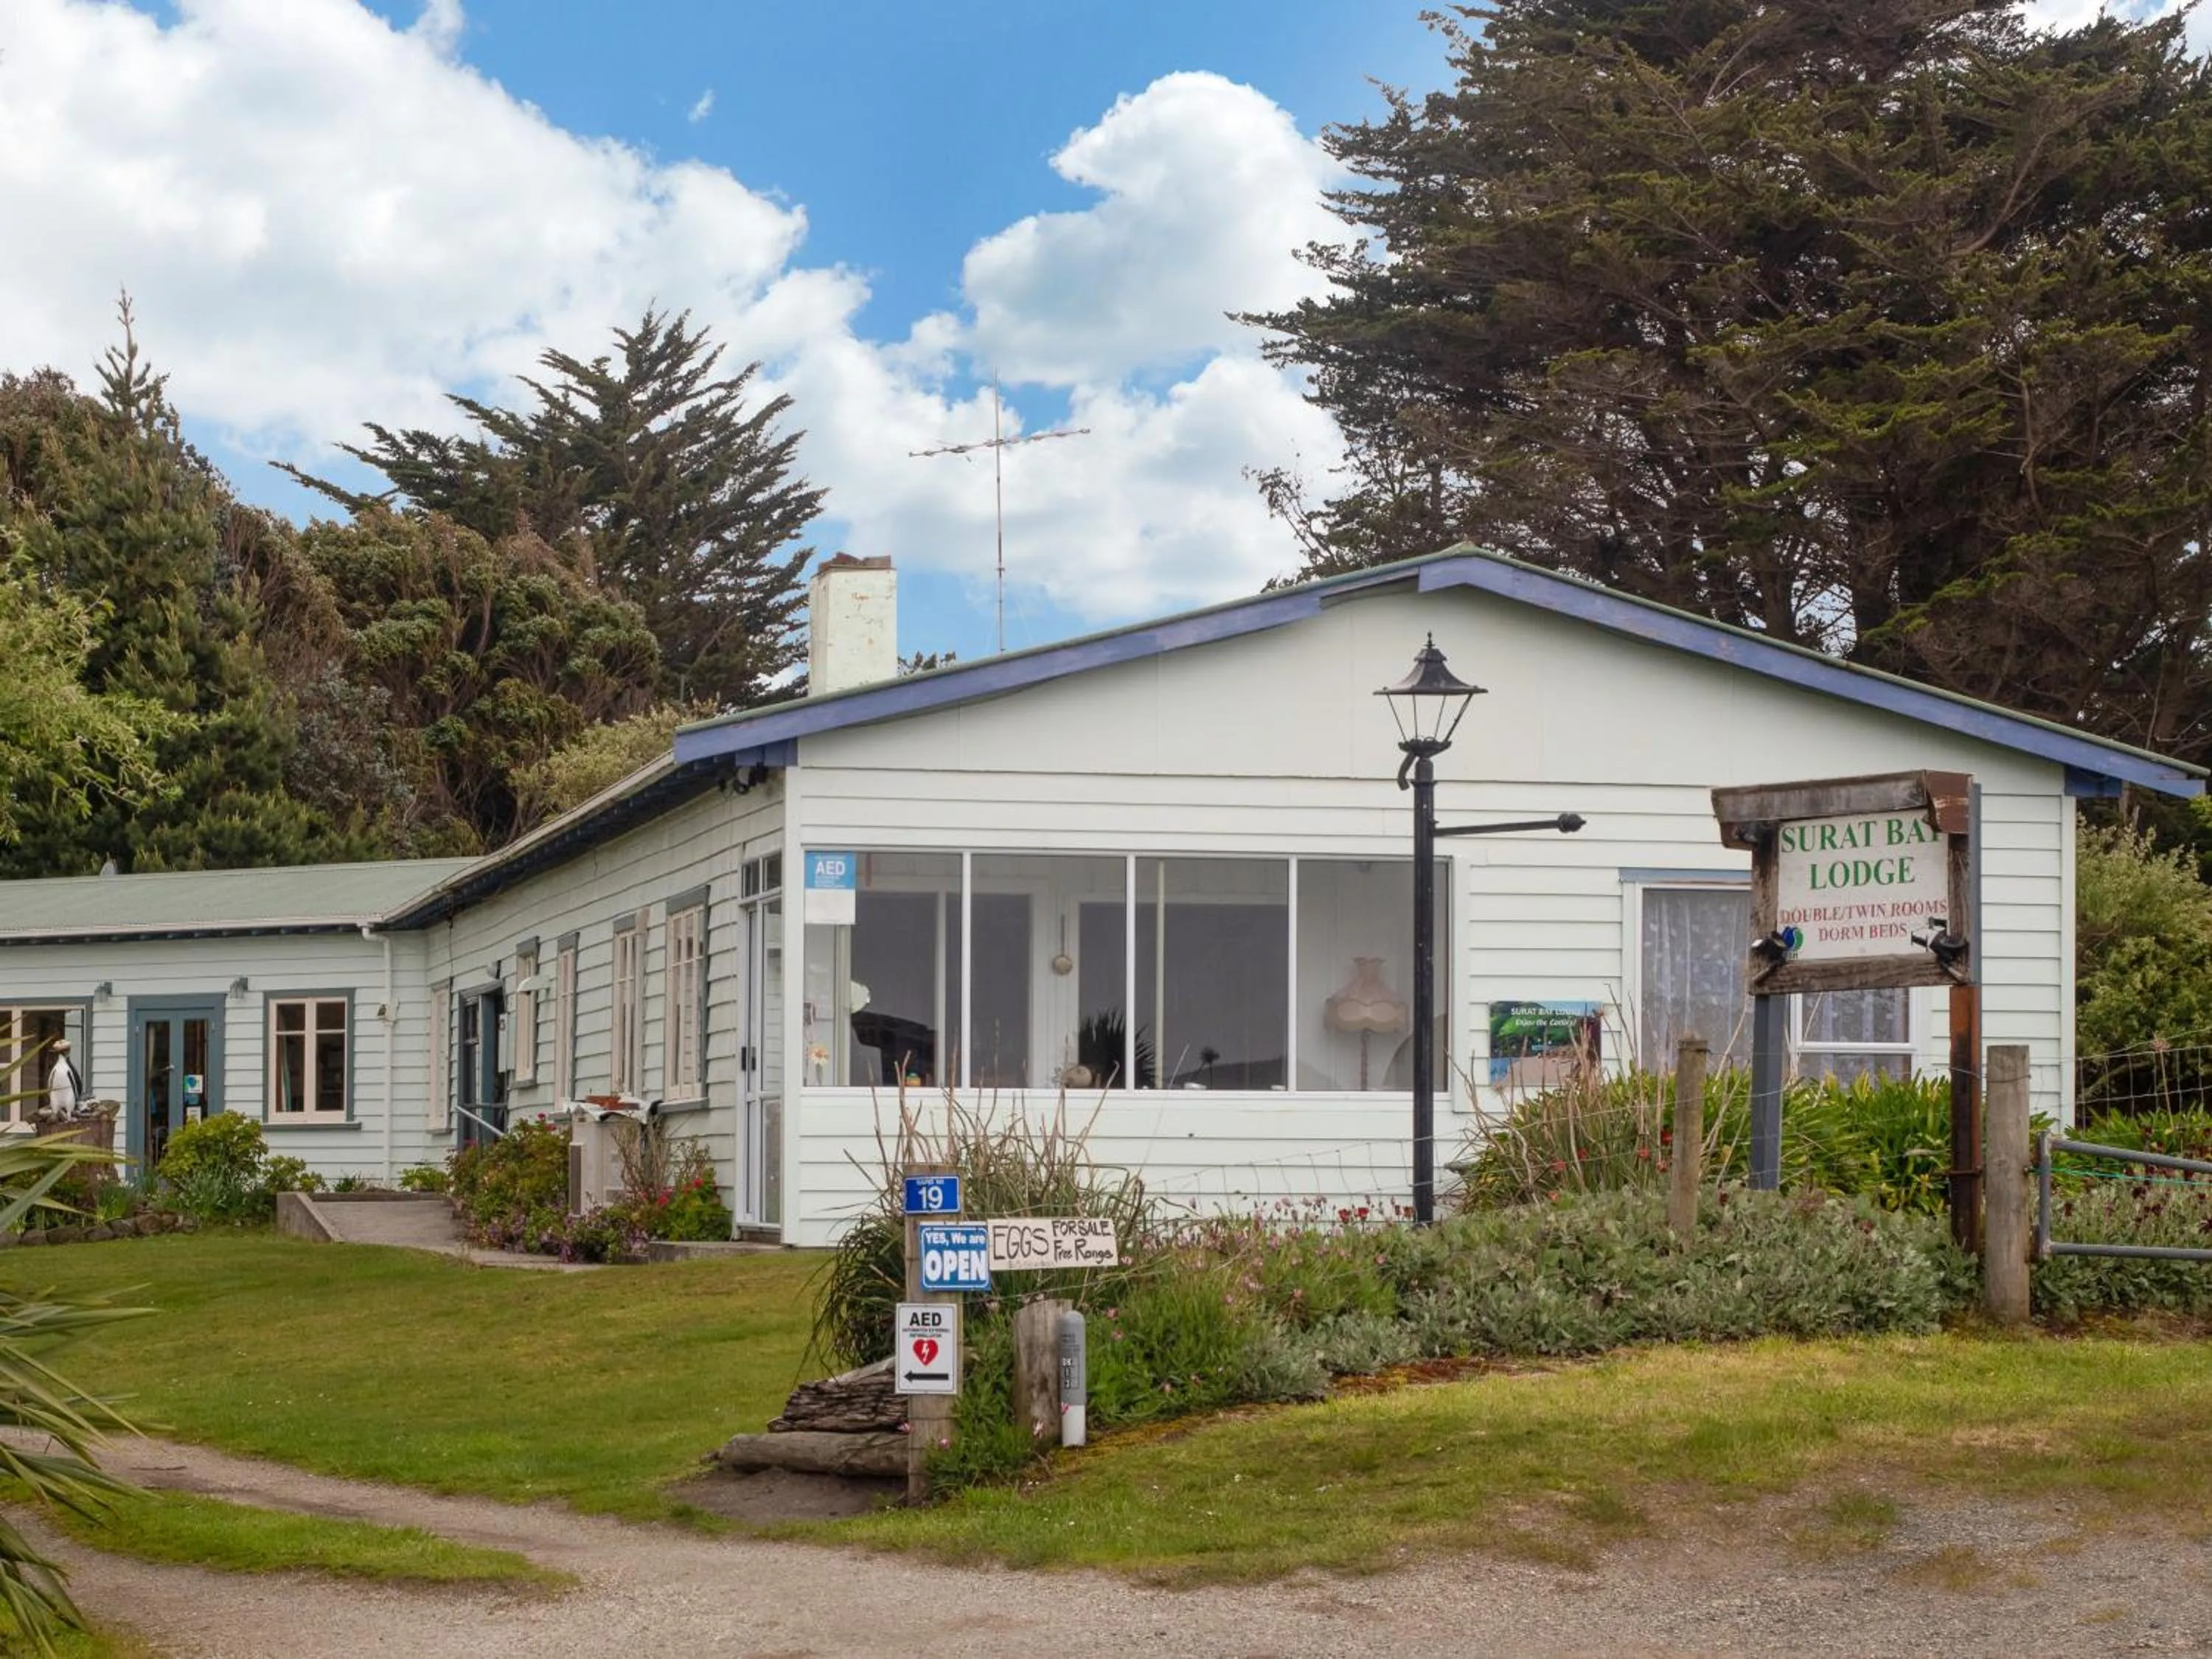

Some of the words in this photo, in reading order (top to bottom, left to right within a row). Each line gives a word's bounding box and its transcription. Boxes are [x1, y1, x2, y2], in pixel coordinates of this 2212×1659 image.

[1781, 821, 1877, 853] SURAT
[815, 860, 846, 876] AED
[1810, 856, 1916, 890] LODGE
[1890, 899, 1948, 917] ROOMS
[1818, 925, 1864, 942] DORM
[1869, 922, 1907, 939] BEDS
[917, 1186, 943, 1209] 19
[925, 1232, 949, 1247] YES,
[950, 1232, 967, 1245] We
[969, 1235, 986, 1245] are
[992, 1225, 1049, 1260] EGGS
[1054, 1239, 1073, 1262] Free
[925, 1249, 987, 1281] OPEN
[909, 1312, 942, 1326] AED
